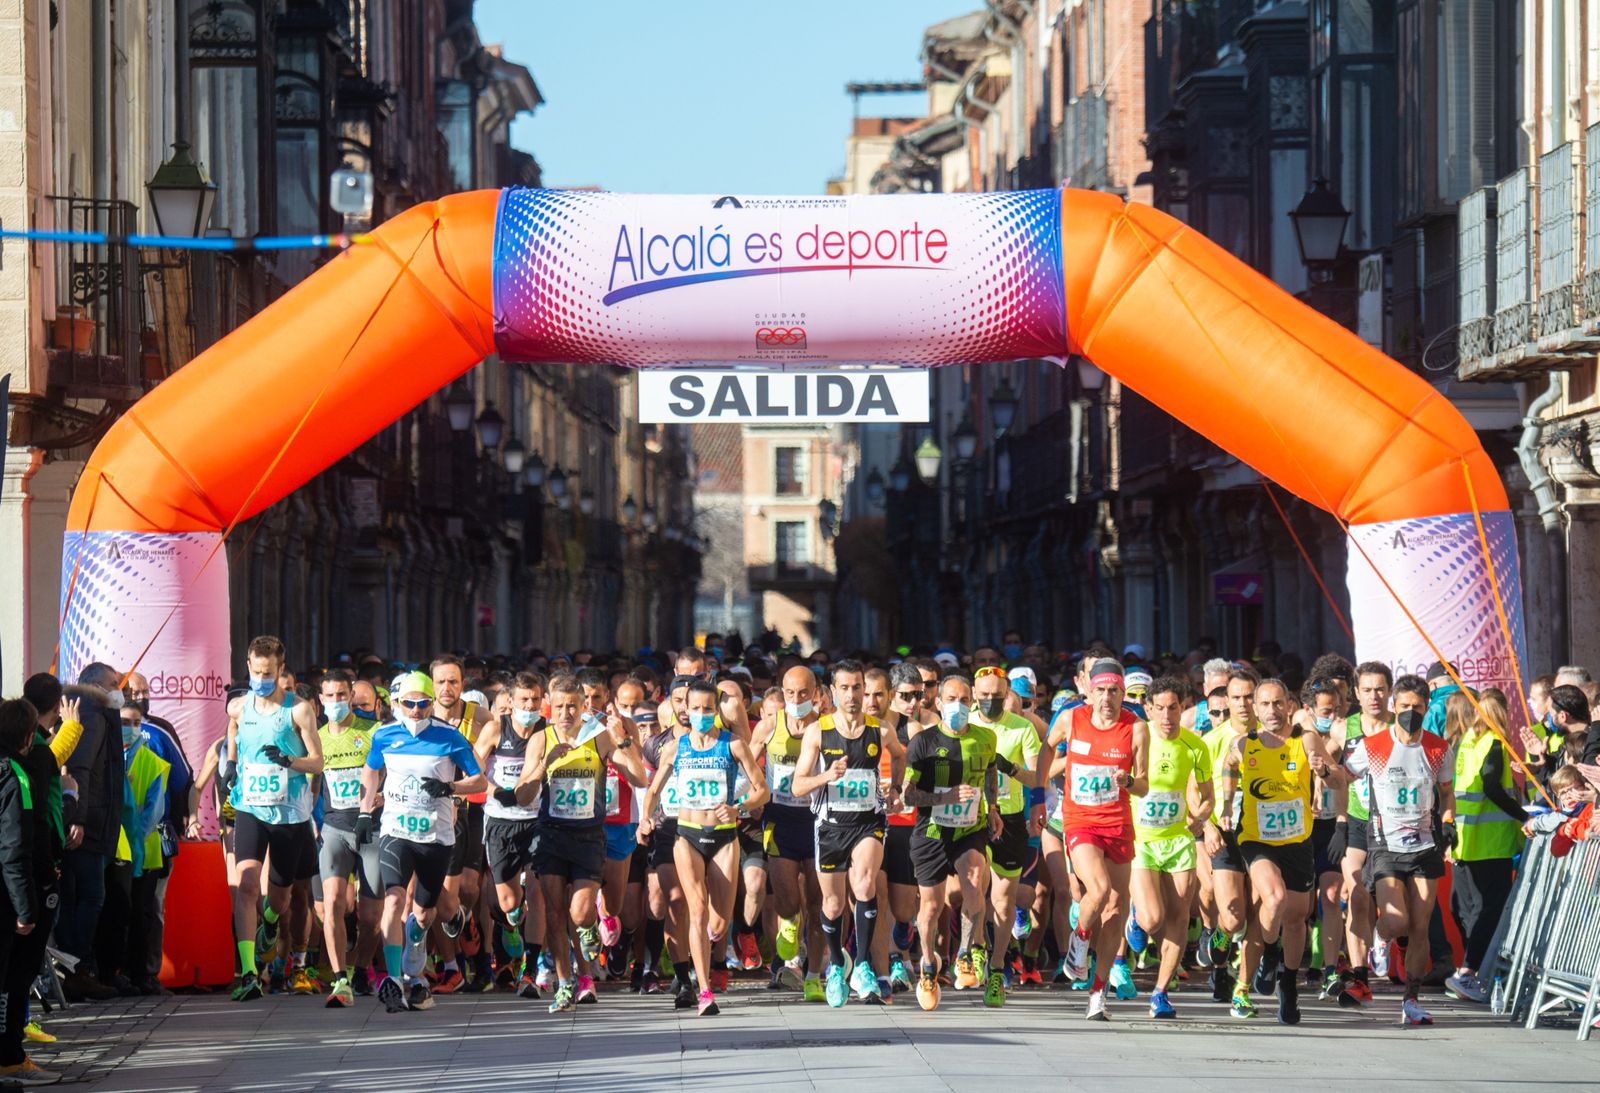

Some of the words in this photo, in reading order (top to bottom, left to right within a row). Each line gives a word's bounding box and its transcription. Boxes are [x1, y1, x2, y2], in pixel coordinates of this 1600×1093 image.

[608, 223, 730, 291] Alcalá
[745, 232, 782, 263] es
[796, 222, 948, 281] deporte
[668, 374, 899, 417] SALIDA
[149, 670, 223, 706] deporte
[249, 775, 280, 793] 295
[332, 779, 360, 798] 122
[686, 780, 719, 797] 318
[836, 780, 869, 798] 126
[1078, 776, 1111, 792] 244
[555, 788, 588, 807] 243
[1397, 787, 1418, 805] 81
[944, 799, 974, 816] 167
[1146, 801, 1179, 817] 379
[396, 814, 430, 833] 199
[1265, 809, 1297, 828] 219
